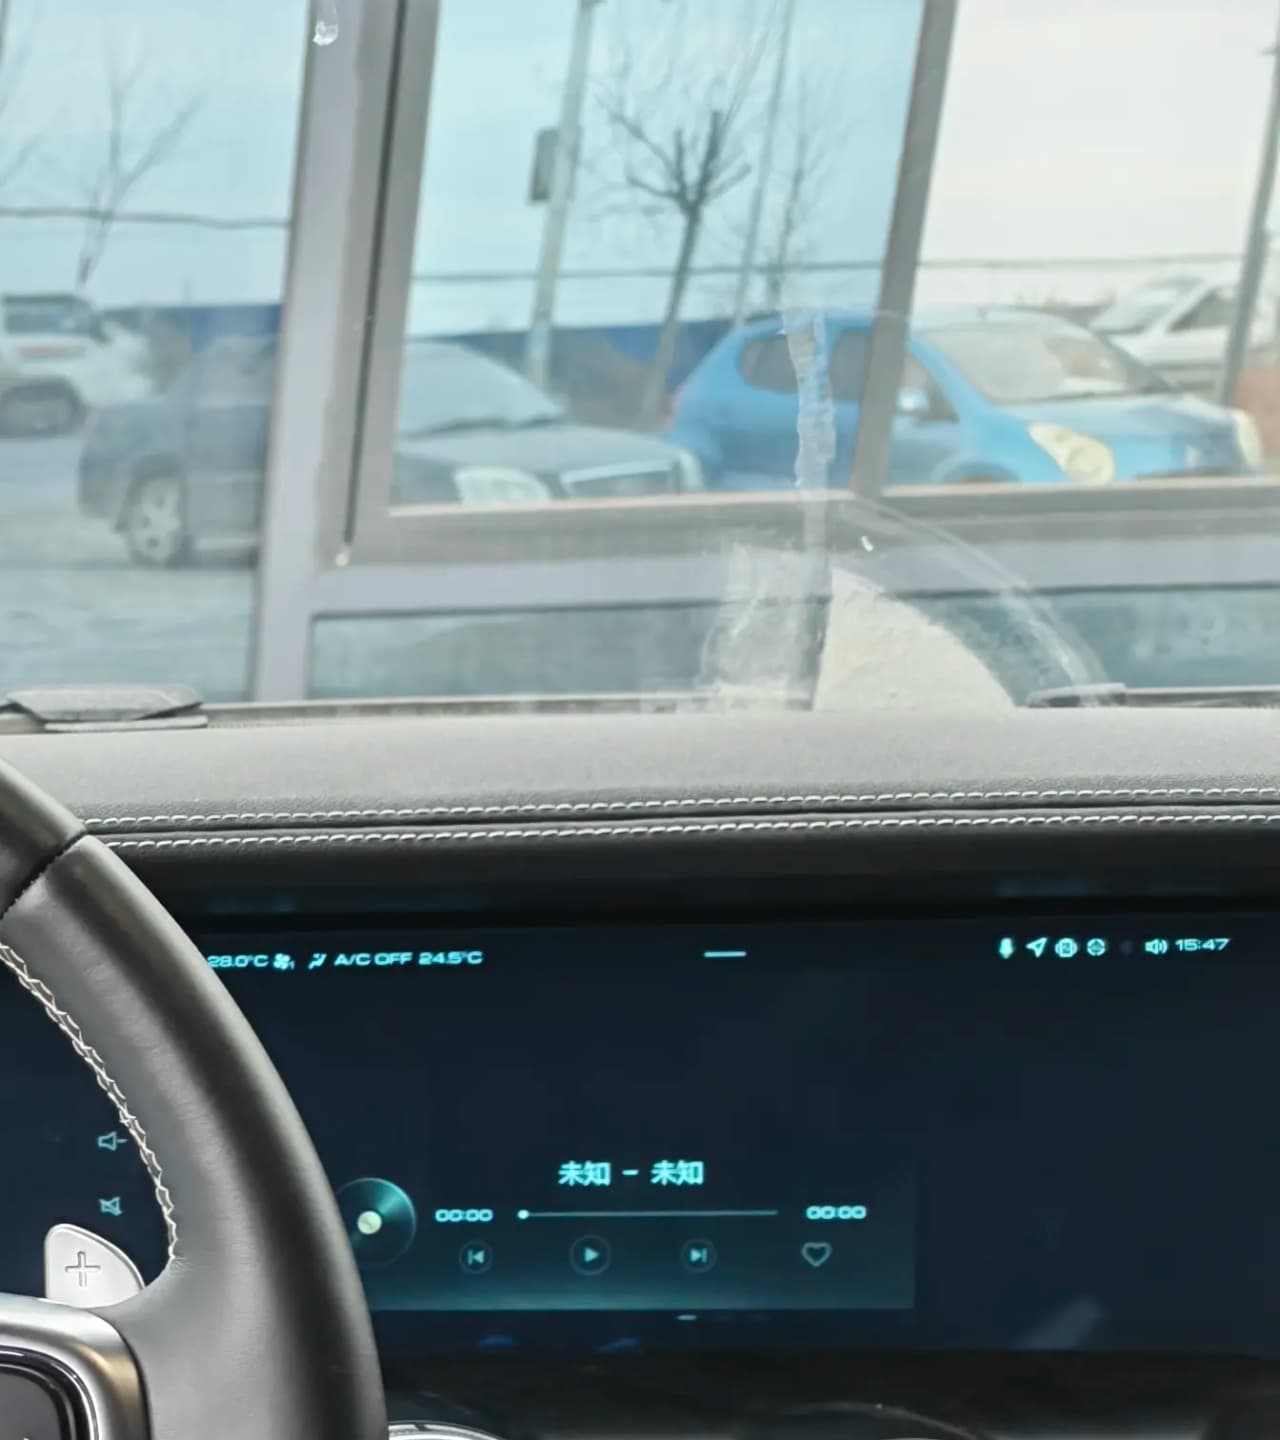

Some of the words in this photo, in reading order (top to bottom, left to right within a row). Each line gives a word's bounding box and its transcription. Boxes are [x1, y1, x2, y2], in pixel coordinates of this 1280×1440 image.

[1175, 937, 1231, 952] 15:47
[334, 952, 372, 967] A/C
[374, 951, 413, 966] OFF
[418, 950, 484, 966] 24.5°C
[558, 1160, 612, 1187] 未知
[650, 1160, 705, 1186] 未知
[434, 1207, 495, 1223] 00:00
[805, 1205, 867, 1220] 00:00
